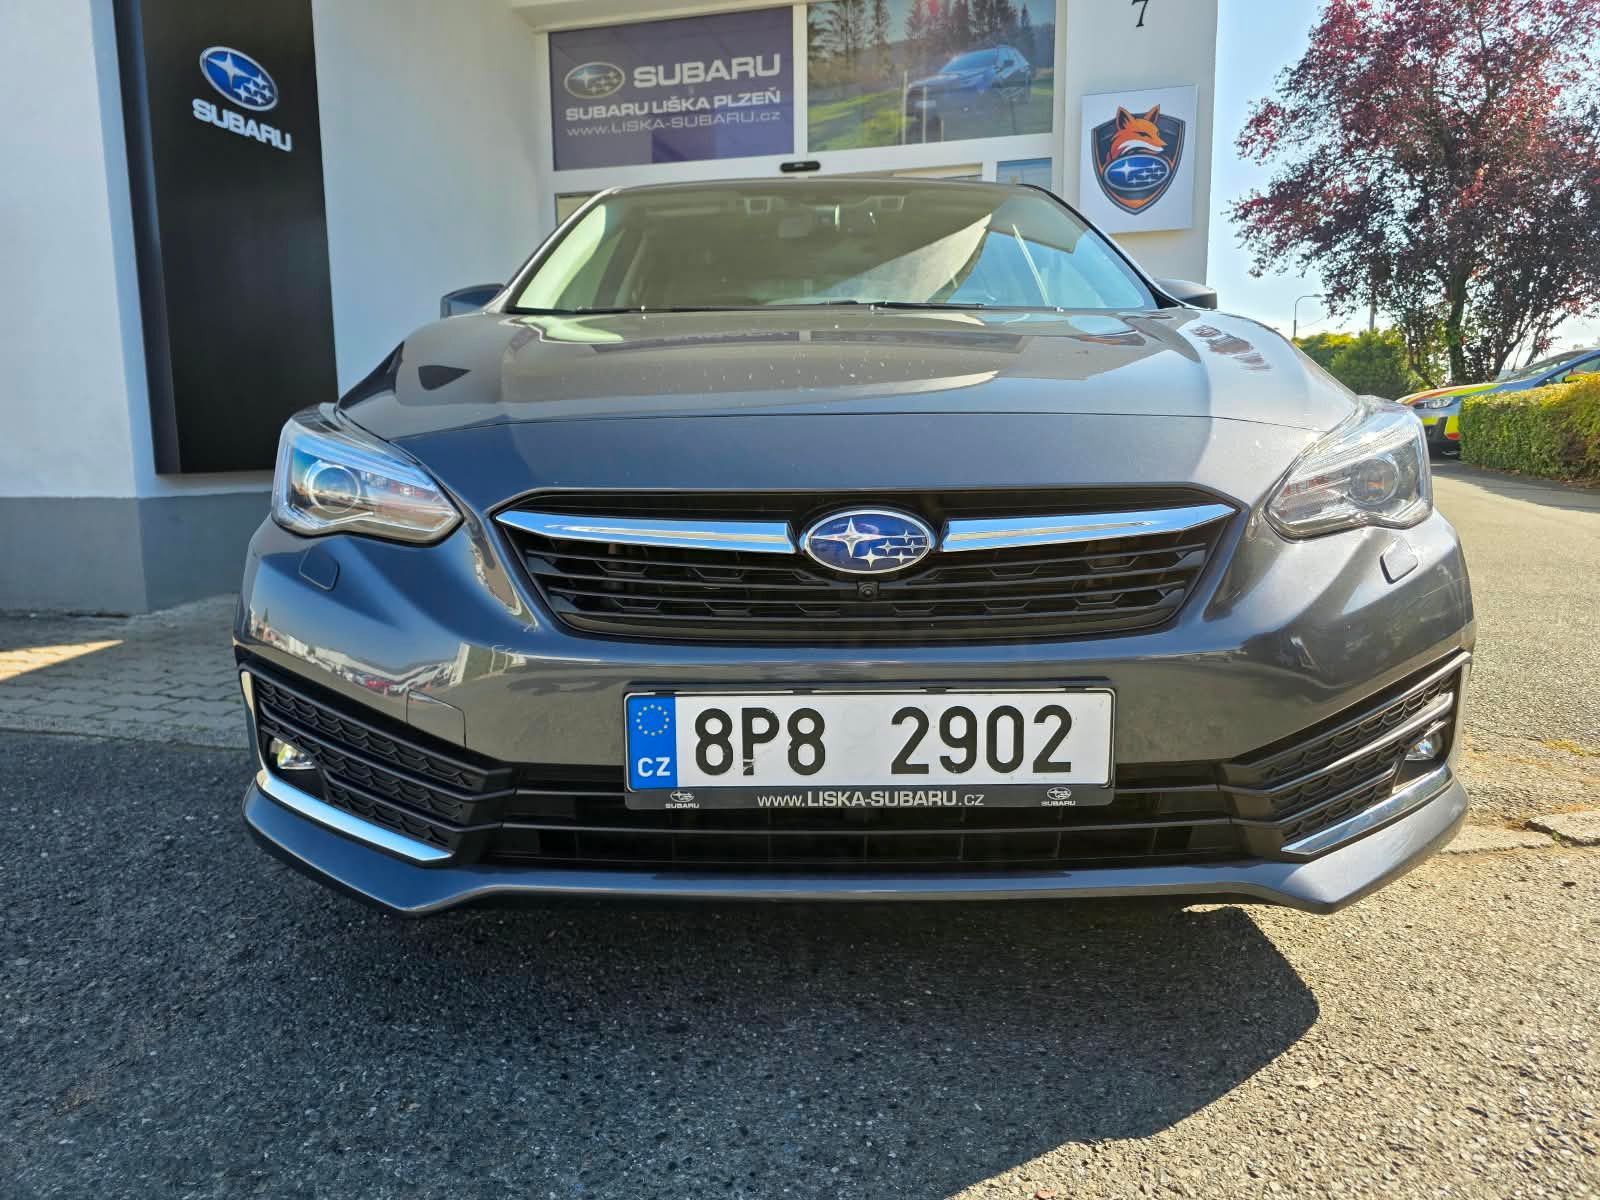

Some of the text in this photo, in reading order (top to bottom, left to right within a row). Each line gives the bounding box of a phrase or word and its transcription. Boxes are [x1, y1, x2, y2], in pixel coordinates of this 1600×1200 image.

[633, 53, 781, 89] SUBARU
[565, 87, 781, 121] SUBARU LIŠKA PLZEŇ
[191, 98, 292, 152] SUBARU
[694, 704, 1073, 777] 8P8 2902
[637, 757, 671, 777] CZ
